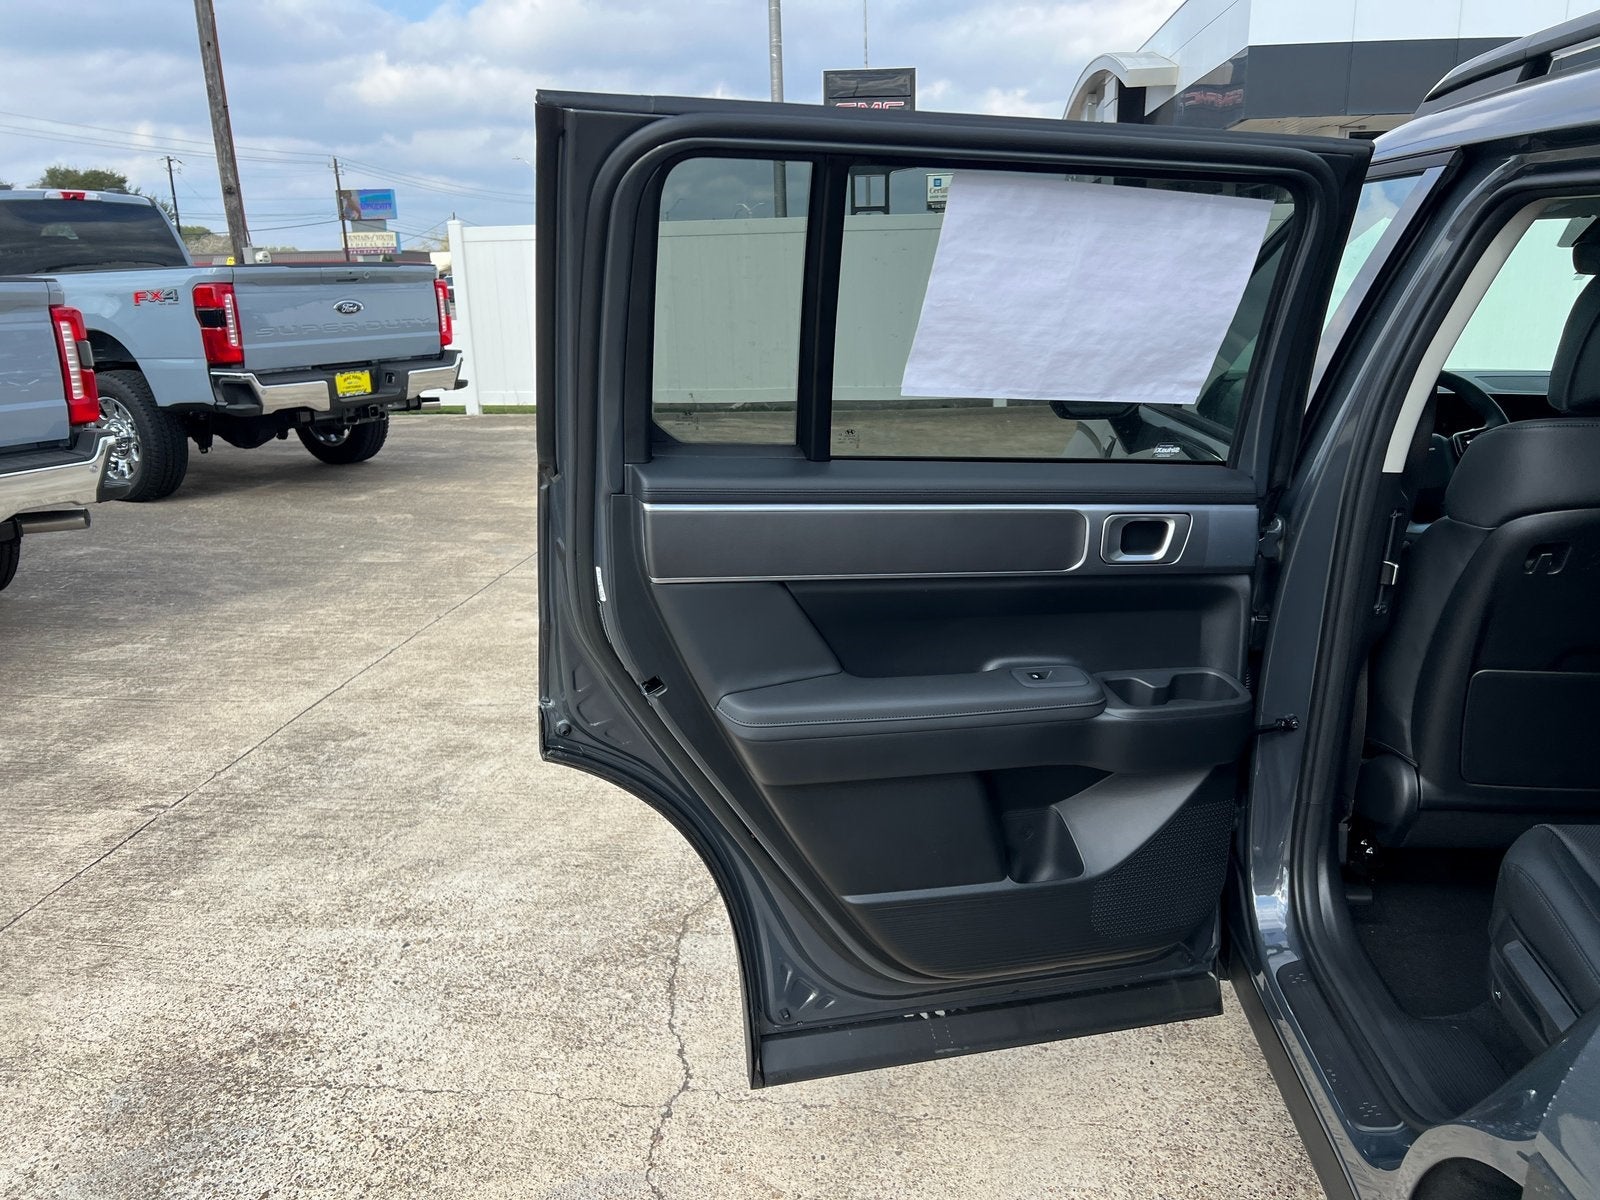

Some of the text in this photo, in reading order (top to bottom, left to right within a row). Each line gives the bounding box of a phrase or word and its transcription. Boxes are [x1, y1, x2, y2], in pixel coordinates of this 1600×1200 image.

[133, 289, 179, 306] FX4
[341, 302, 359, 313] Ford
[255, 317, 432, 337] SUPER DUTY
